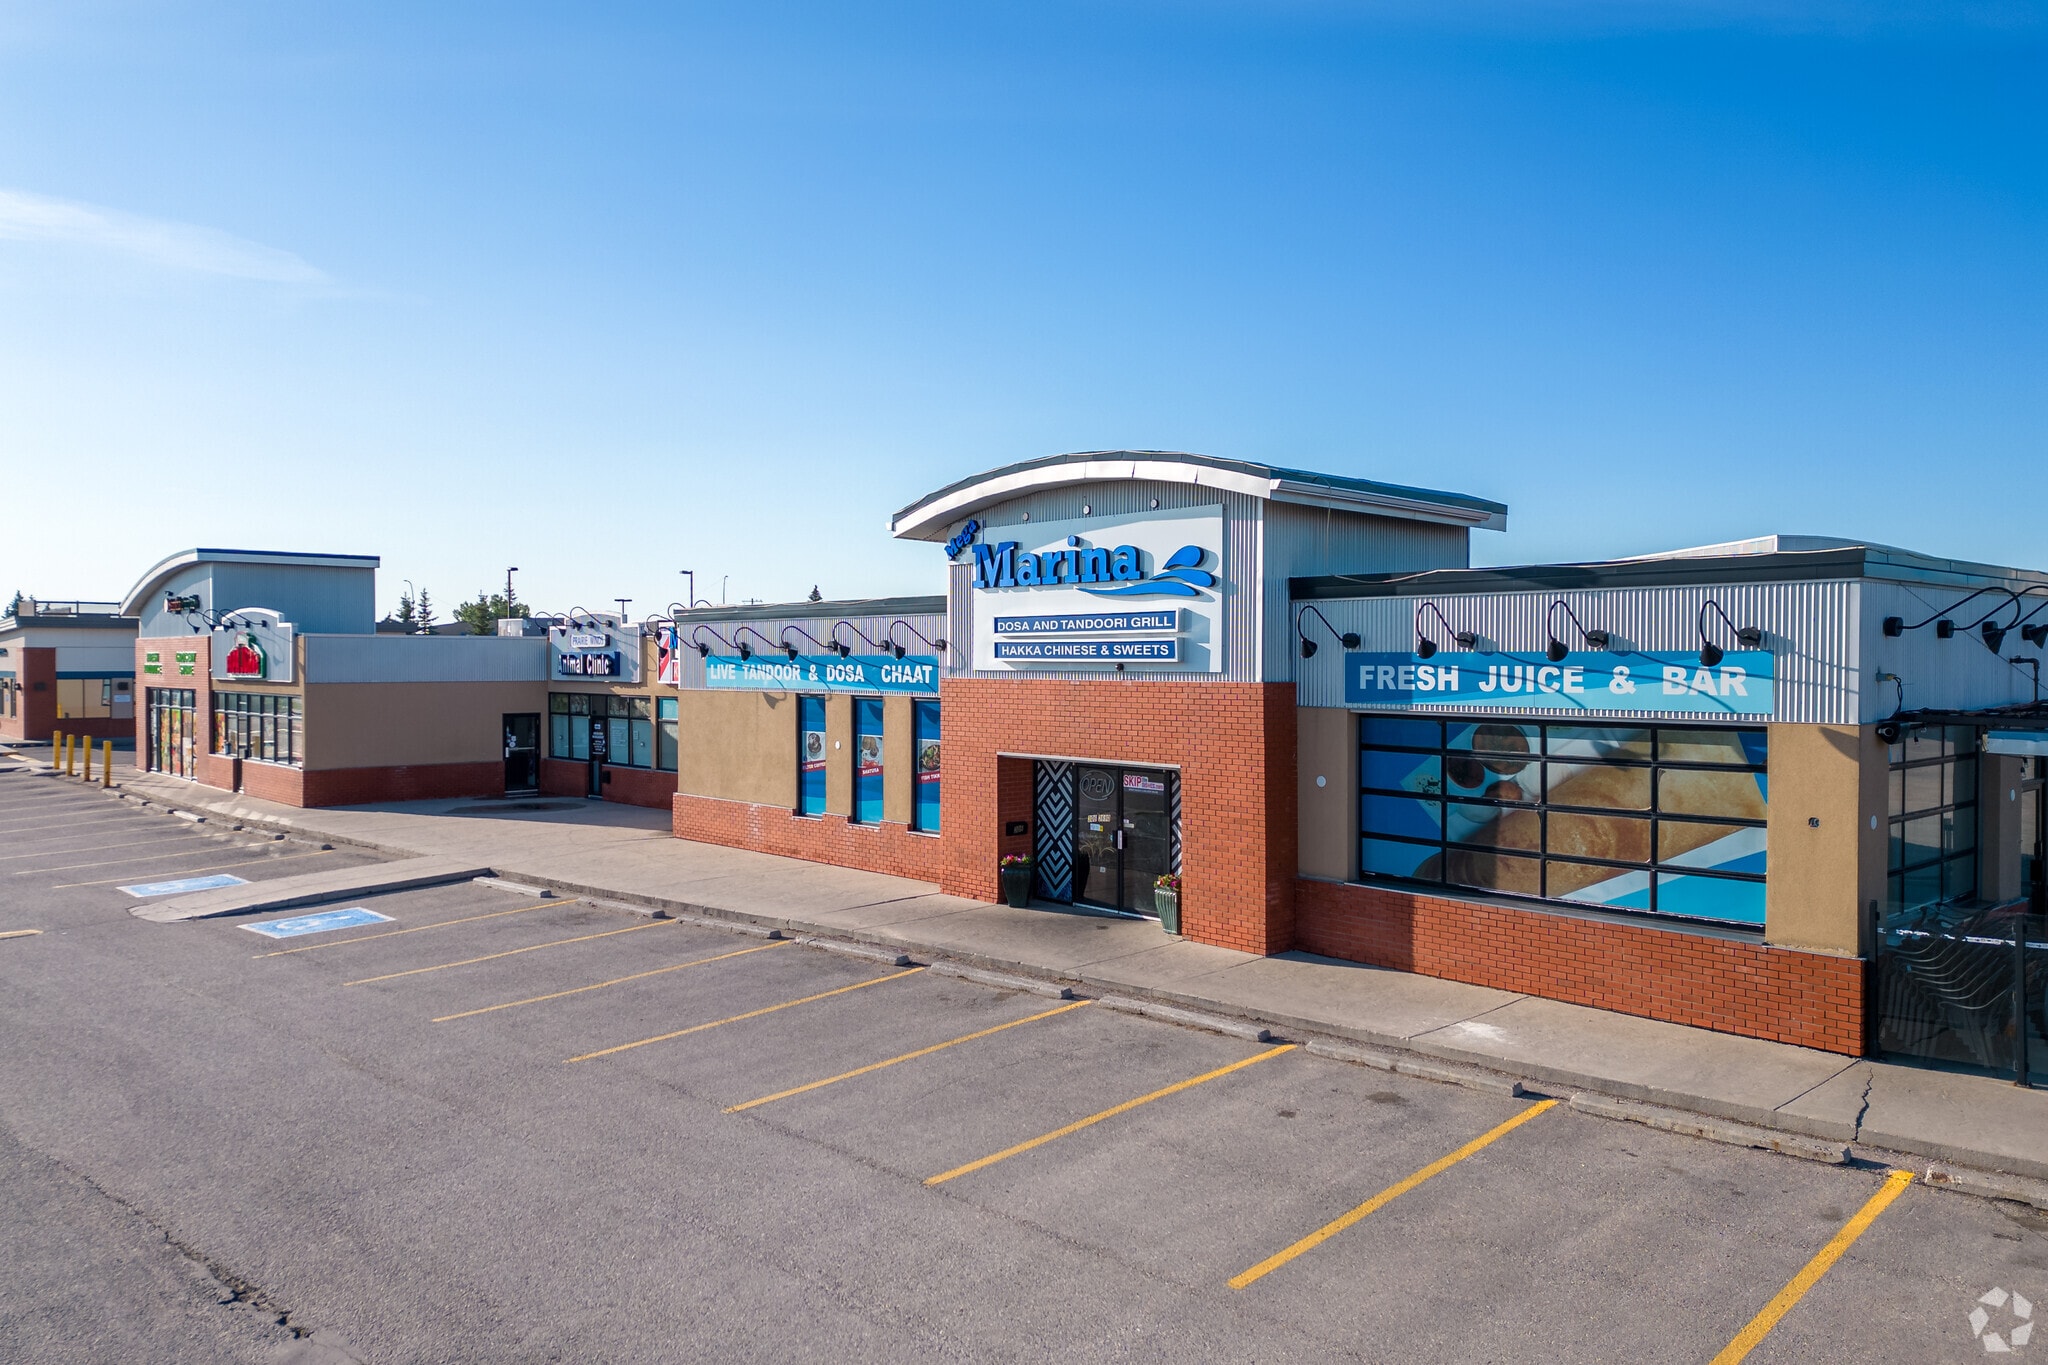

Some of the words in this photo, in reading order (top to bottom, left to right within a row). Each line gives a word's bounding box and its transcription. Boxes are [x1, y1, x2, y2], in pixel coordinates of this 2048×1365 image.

[944, 519, 980, 561] Mega
[972, 535, 1141, 589] Marina
[997, 621, 1030, 632] DOSA
[1033, 620, 1058, 631] AND
[1060, 618, 1127, 630] TANDOORI
[1130, 616, 1172, 628] GRILL
[1001, 645, 1042, 656] HAKKA
[1044, 645, 1097, 656] CHINESE
[1100, 645, 1110, 656] &
[1113, 644, 1169, 656] SWEETS
[586, 653, 609, 675] Clinic
[710, 664, 736, 680] LIVE
[742, 663, 801, 681] TANDOOR
[808, 664, 818, 681] &
[826, 663, 865, 683] DOSA
[881, 664, 933, 684] CHAAT
[1359, 665, 1459, 692] FRESH
[1478, 665, 1585, 694] JUICE
[1608, 665, 1637, 696] &
[1662, 666, 1749, 697] BAR
[1081, 777, 1112, 794] OPEN
[1123, 774, 1142, 787] SKIP
